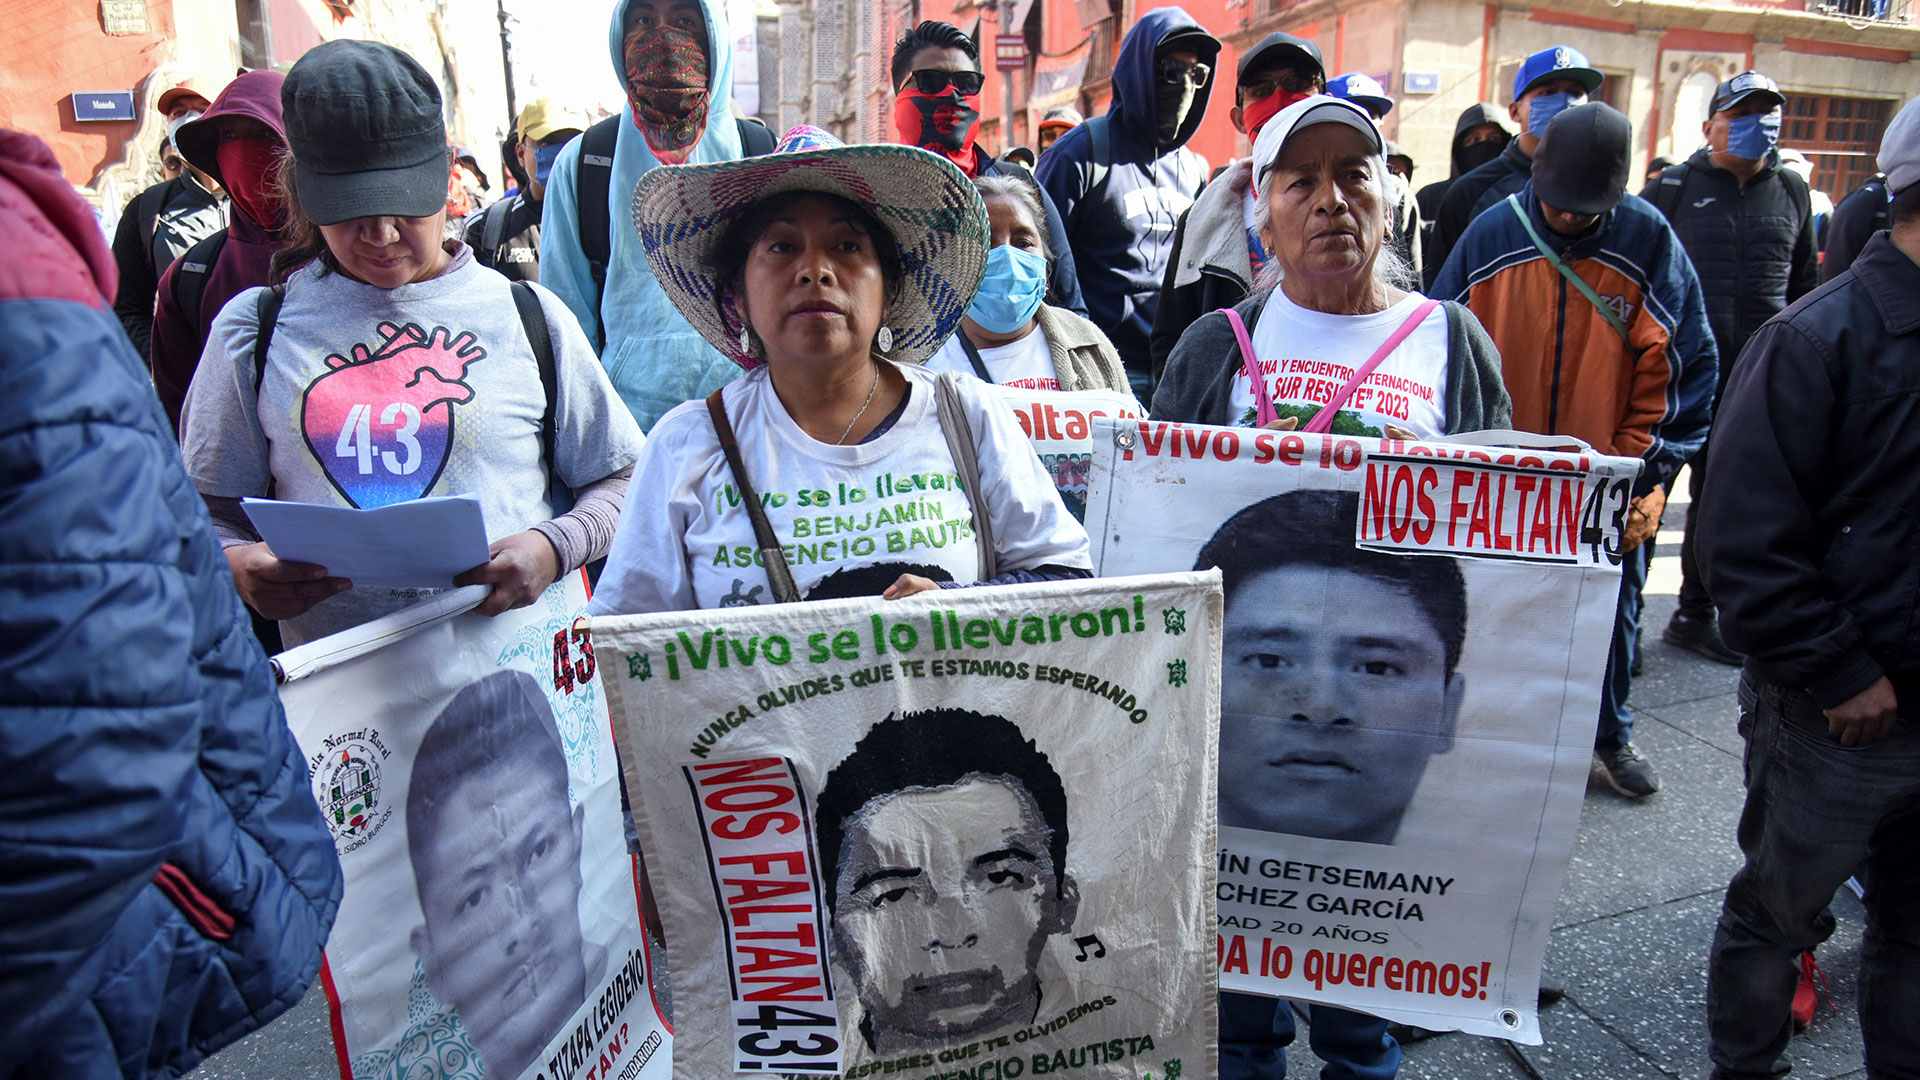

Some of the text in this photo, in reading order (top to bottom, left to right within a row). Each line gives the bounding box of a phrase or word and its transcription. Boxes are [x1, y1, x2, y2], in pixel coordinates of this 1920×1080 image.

[92, 100, 116, 110] Moneda
[516, 254, 535, 264] CITY
[1272, 376, 1303, 400] SUR
[1376, 390, 1409, 421] 2023
[1281, 359, 1289, 373] Y
[1289, 360, 1355, 382] ENCUENTRO
[1362, 372, 1435, 406] TERNACIONAL
[335, 402, 422, 475] 43
[1254, 433, 1305, 466] se
[1319, 434, 1362, 471] lo
[797, 488, 830, 507] se
[838, 482, 868, 506] lo
[1361, 463, 1439, 546] NOS
[792, 496, 944, 538] BENJAMÍN
[553, 616, 596, 697] 43
[664, 594, 1146, 680] ¡Vivo se lo llevaron!
[690, 658, 1148, 760] NUNCA OLVIDES QUE TE ESTAMOS ESPERANDO
[323, 727, 368, 753] Normal
[369, 729, 392, 760] Rural
[329, 781, 376, 815] AYOTZINAPA
[693, 757, 801, 840] NOS
[344, 836, 368, 854] ISIDRO
[1259, 858, 1455, 896] GETSEMANY
[1216, 881, 1425, 922] CHEZ GARCÍA
[718, 851, 825, 1002] FALTAN
[1270, 920, 1304, 935] 20
[1311, 924, 1389, 945] AÑOS
[1259, 937, 1294, 979] lo
[1303, 948, 1492, 1001] queremos!
[844, 995, 1118, 1080] ESPERES QUE TE OLVIDEMOS
[1031, 1034, 1156, 1076] BAUTISTA
